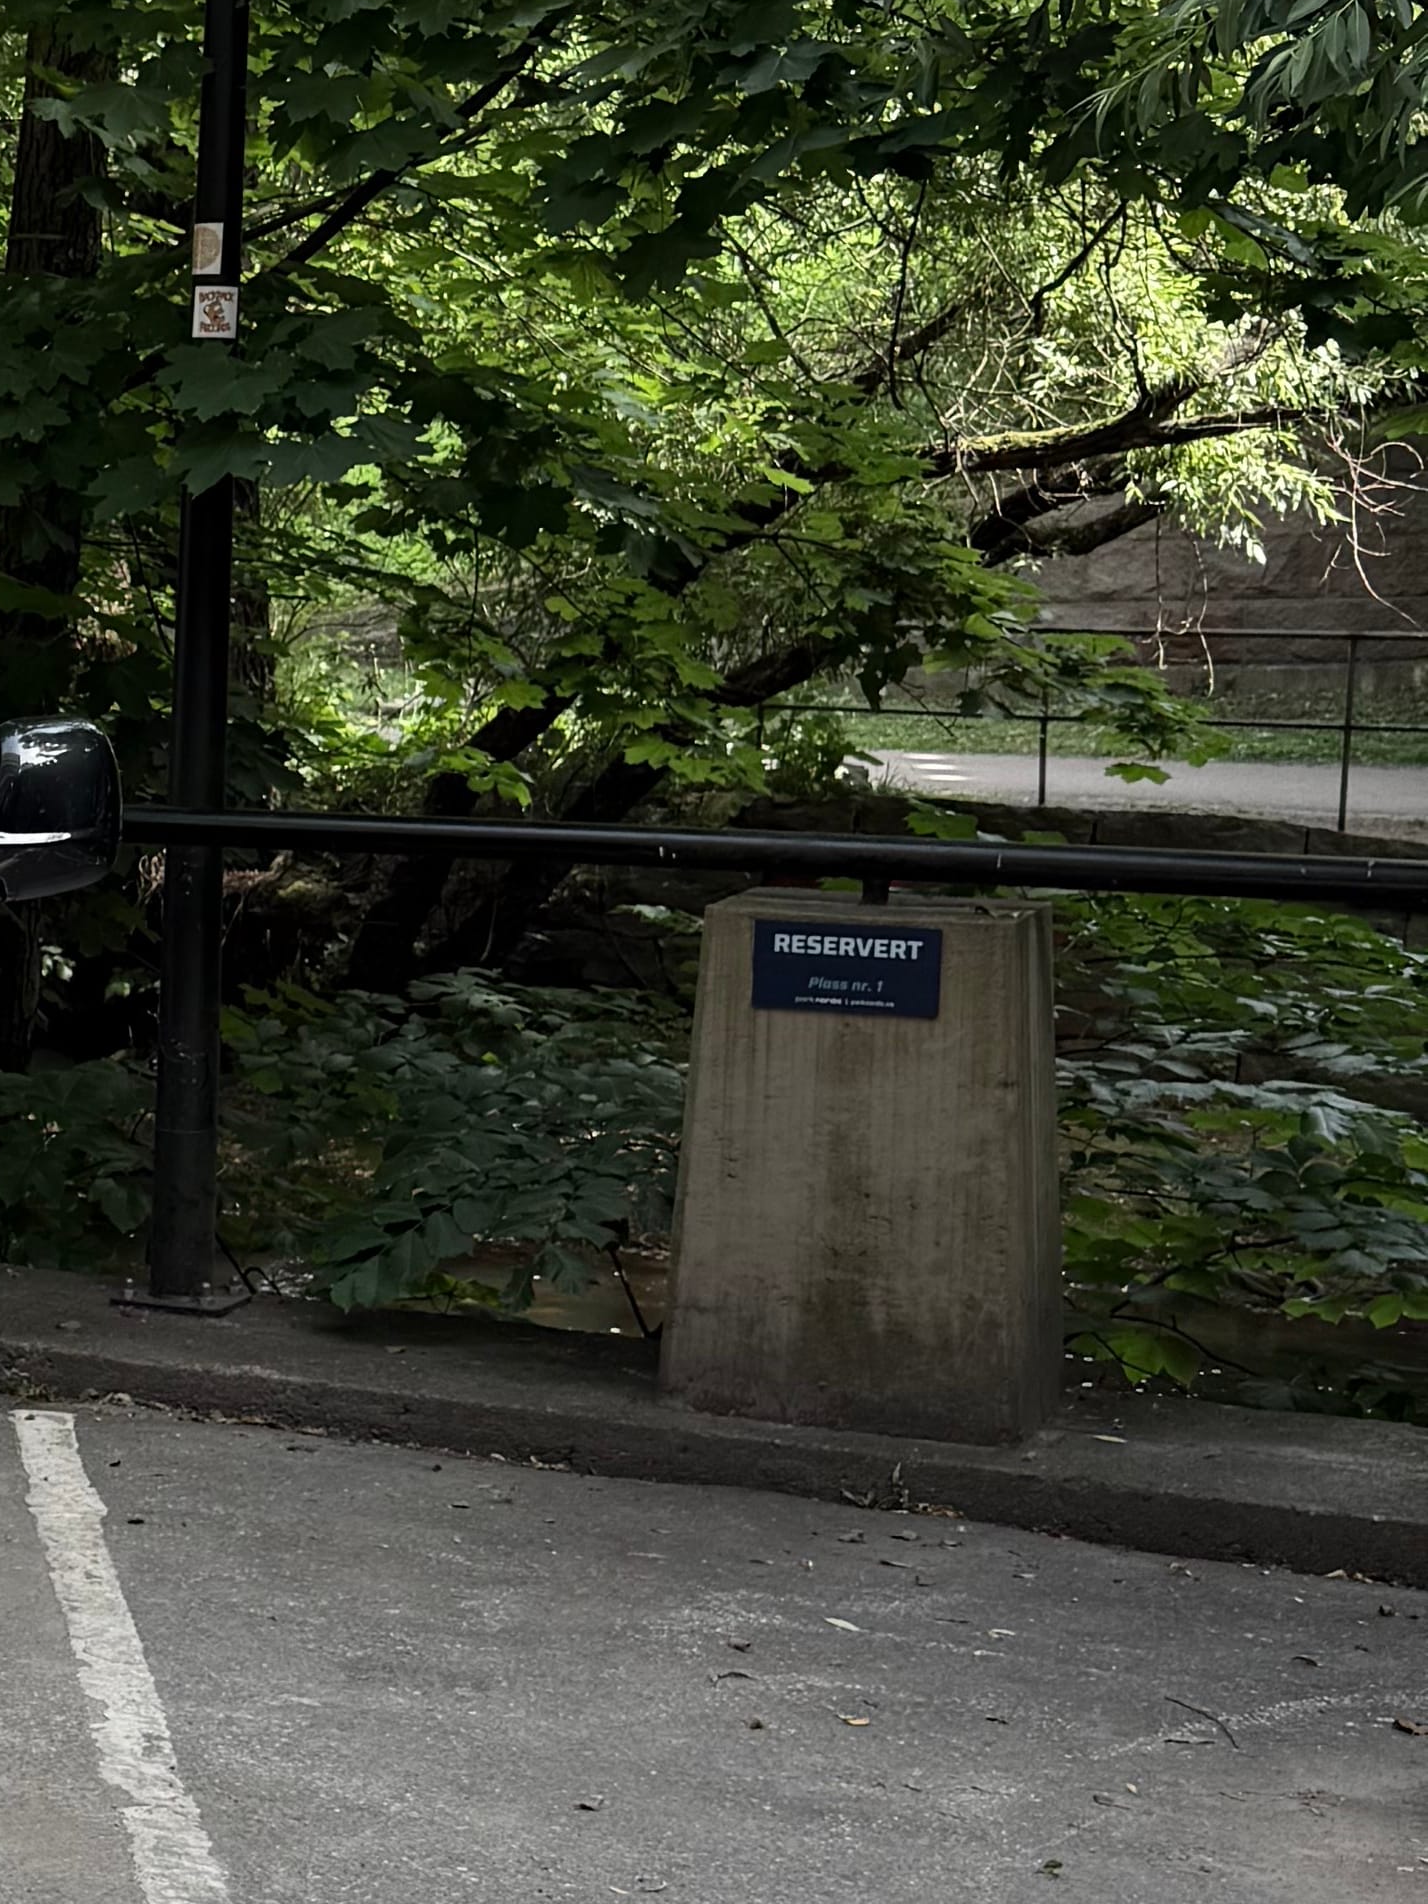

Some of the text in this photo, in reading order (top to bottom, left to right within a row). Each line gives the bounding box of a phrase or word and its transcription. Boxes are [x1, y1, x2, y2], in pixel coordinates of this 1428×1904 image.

[773, 933, 923, 960] RESERVERT
[808, 977, 883, 993] Plass nr. 1
